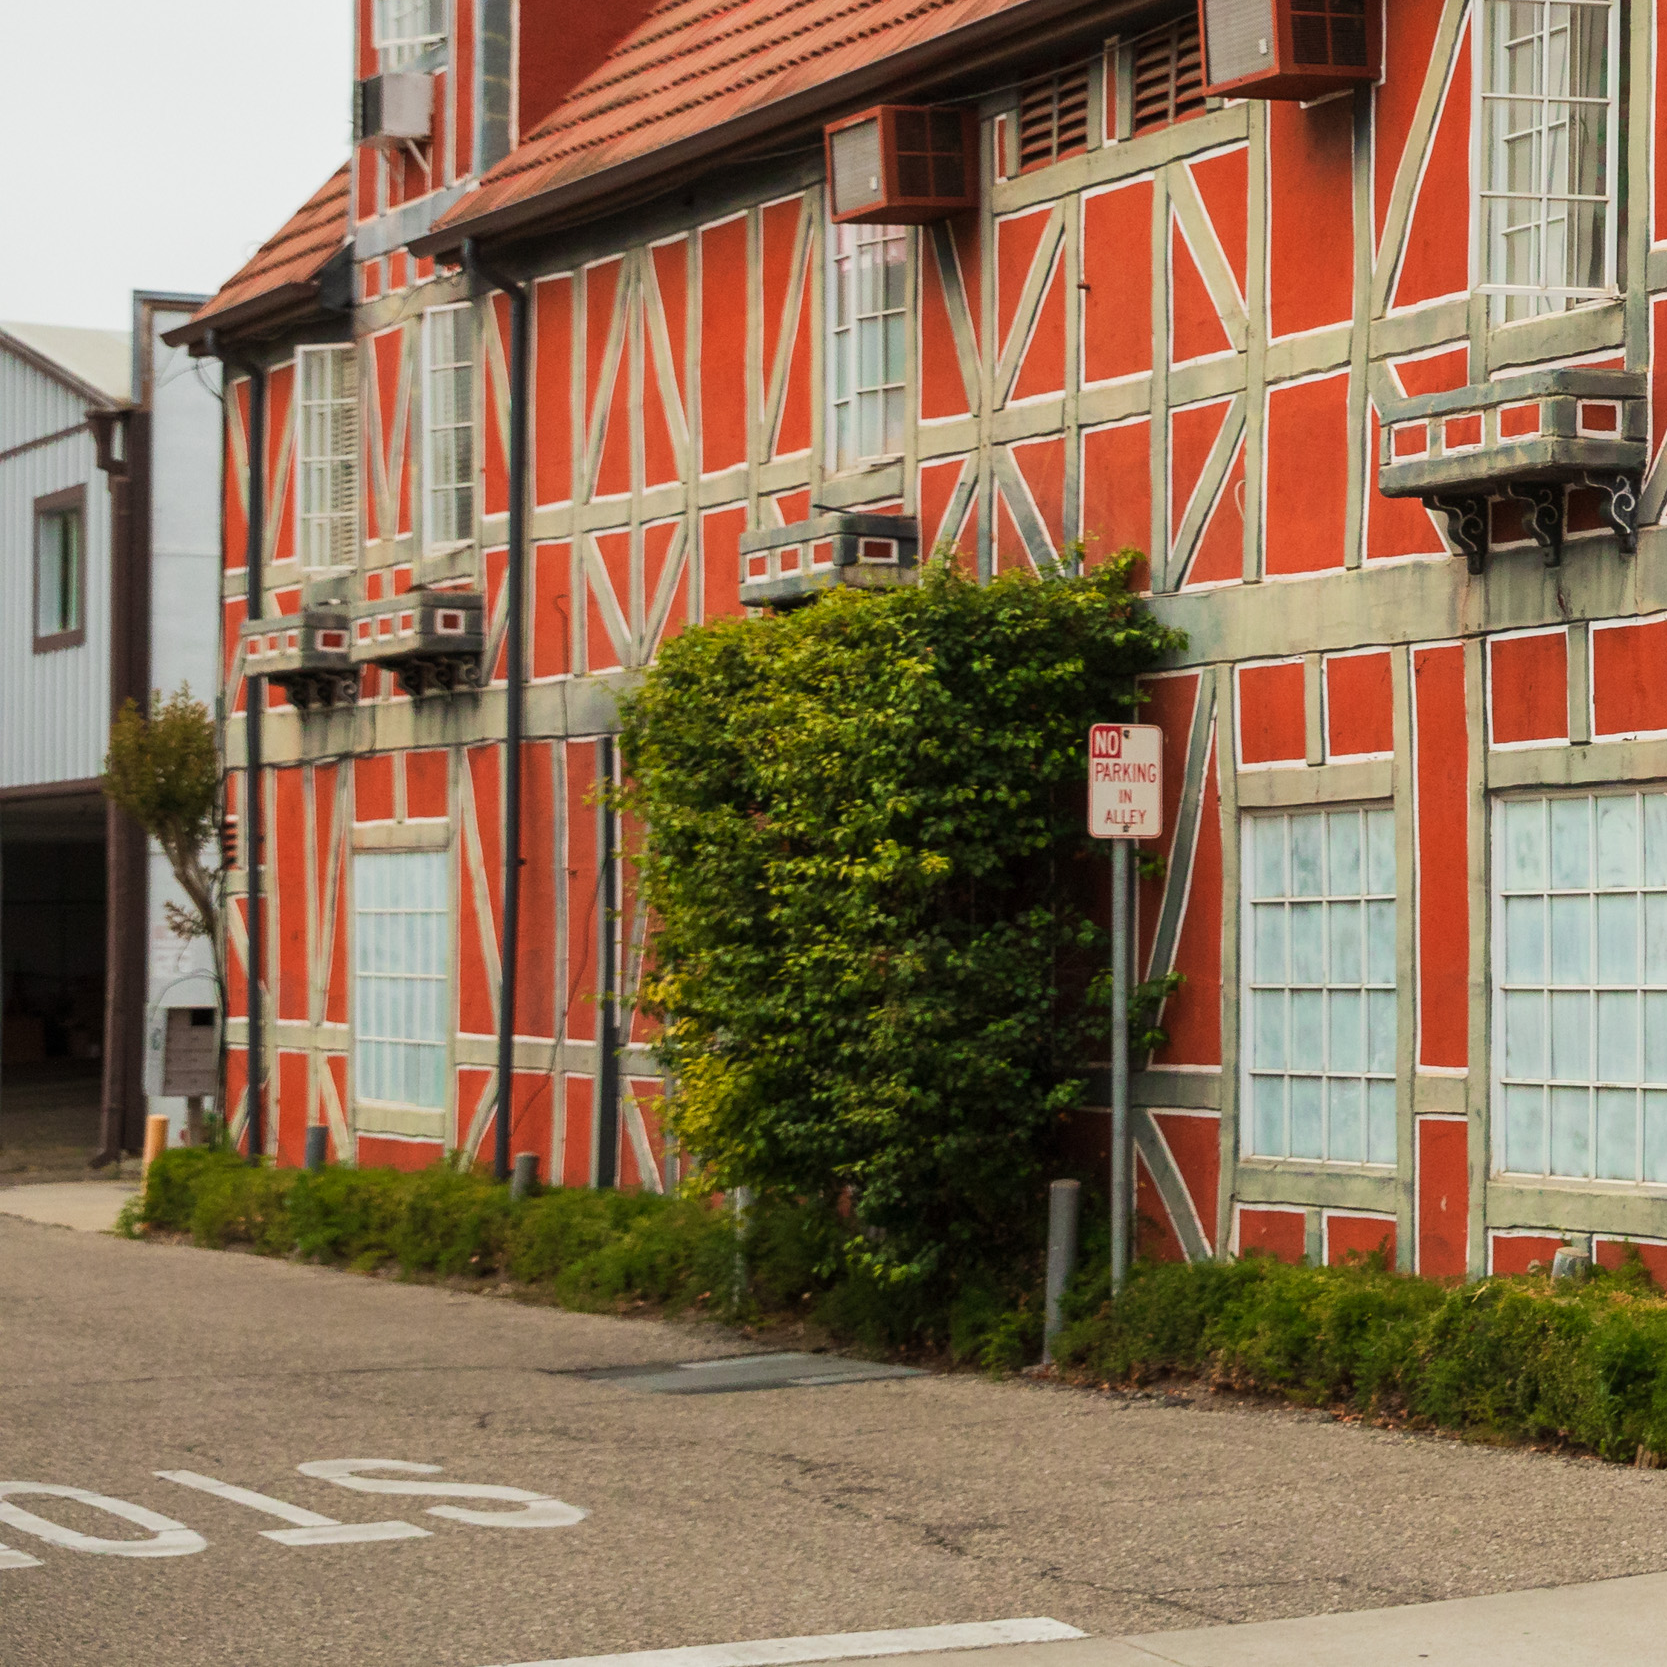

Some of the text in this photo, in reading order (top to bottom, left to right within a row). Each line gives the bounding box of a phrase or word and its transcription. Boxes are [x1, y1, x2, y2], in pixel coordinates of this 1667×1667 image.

[1095, 730, 1119, 755] NO
[1095, 762, 1157, 783] PARKING
[1118, 789, 1132, 804] IN
[1104, 809, 1147, 824] ALLEY
[0, 1458, 587, 1570] STO
